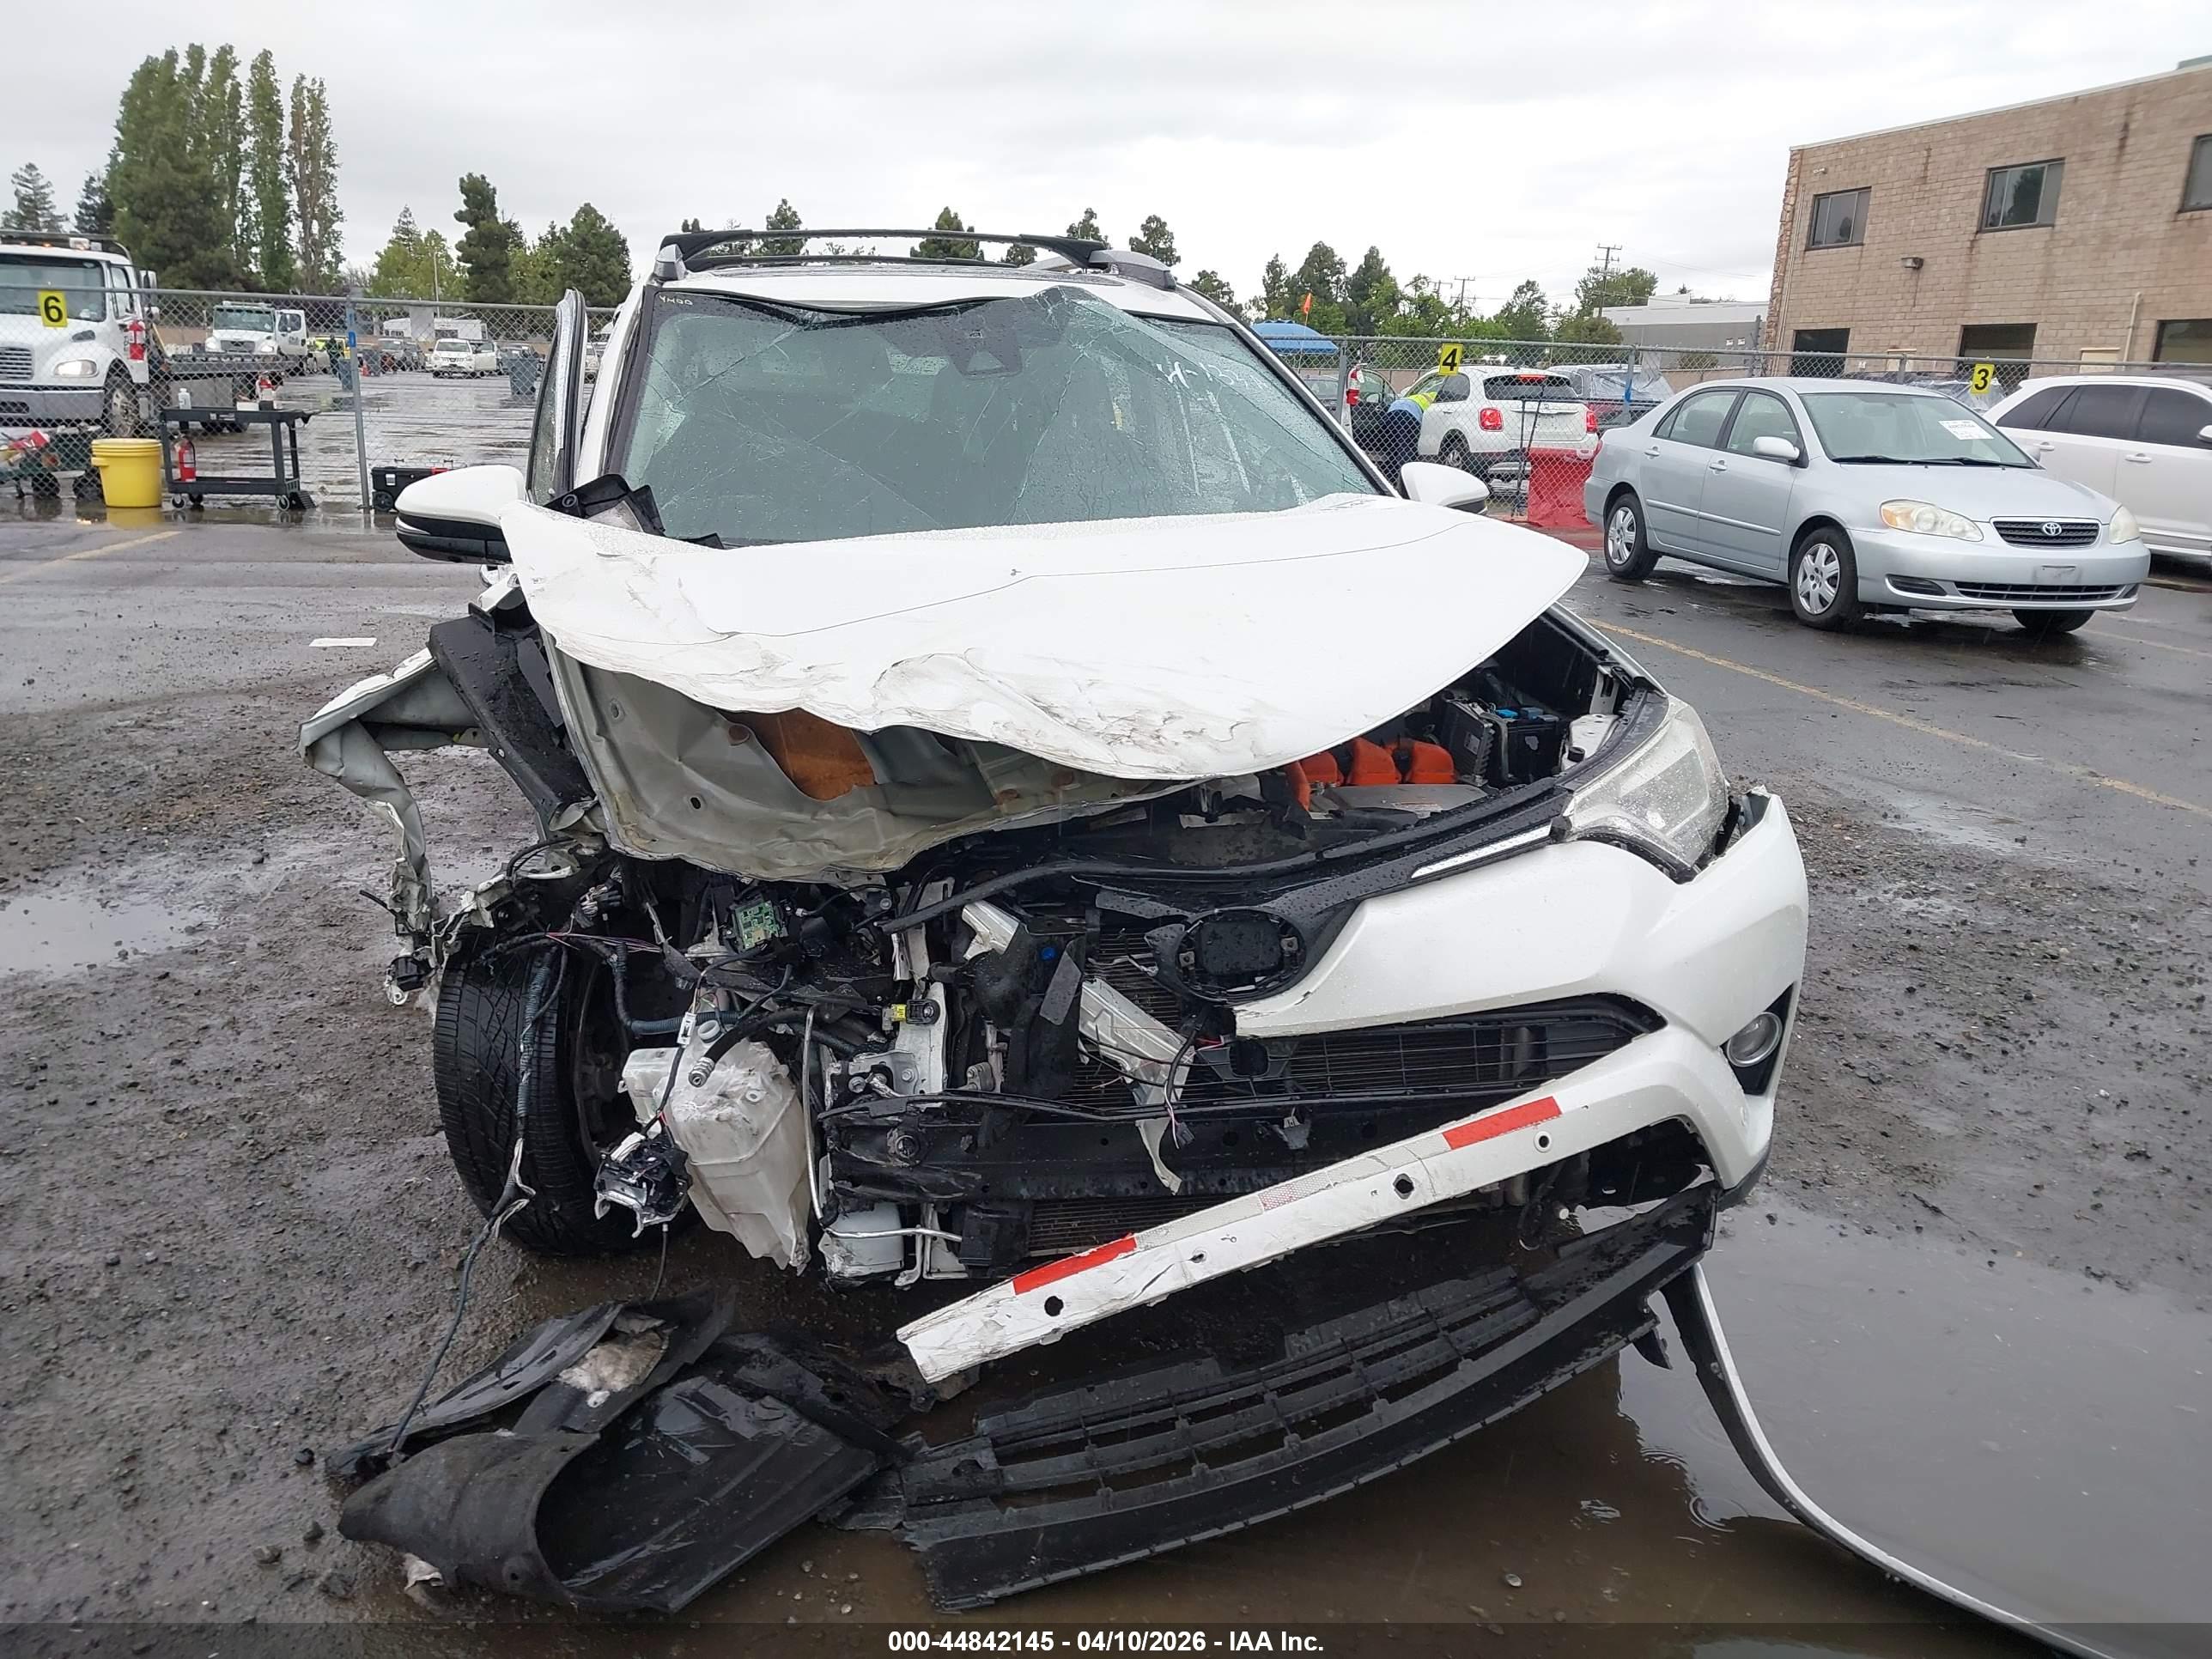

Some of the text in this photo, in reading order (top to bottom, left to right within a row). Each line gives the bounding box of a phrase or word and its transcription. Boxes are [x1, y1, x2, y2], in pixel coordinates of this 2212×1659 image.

[44, 295, 64, 323] 6
[1442, 348, 1458, 372] 4
[1974, 368, 1990, 391] 3
